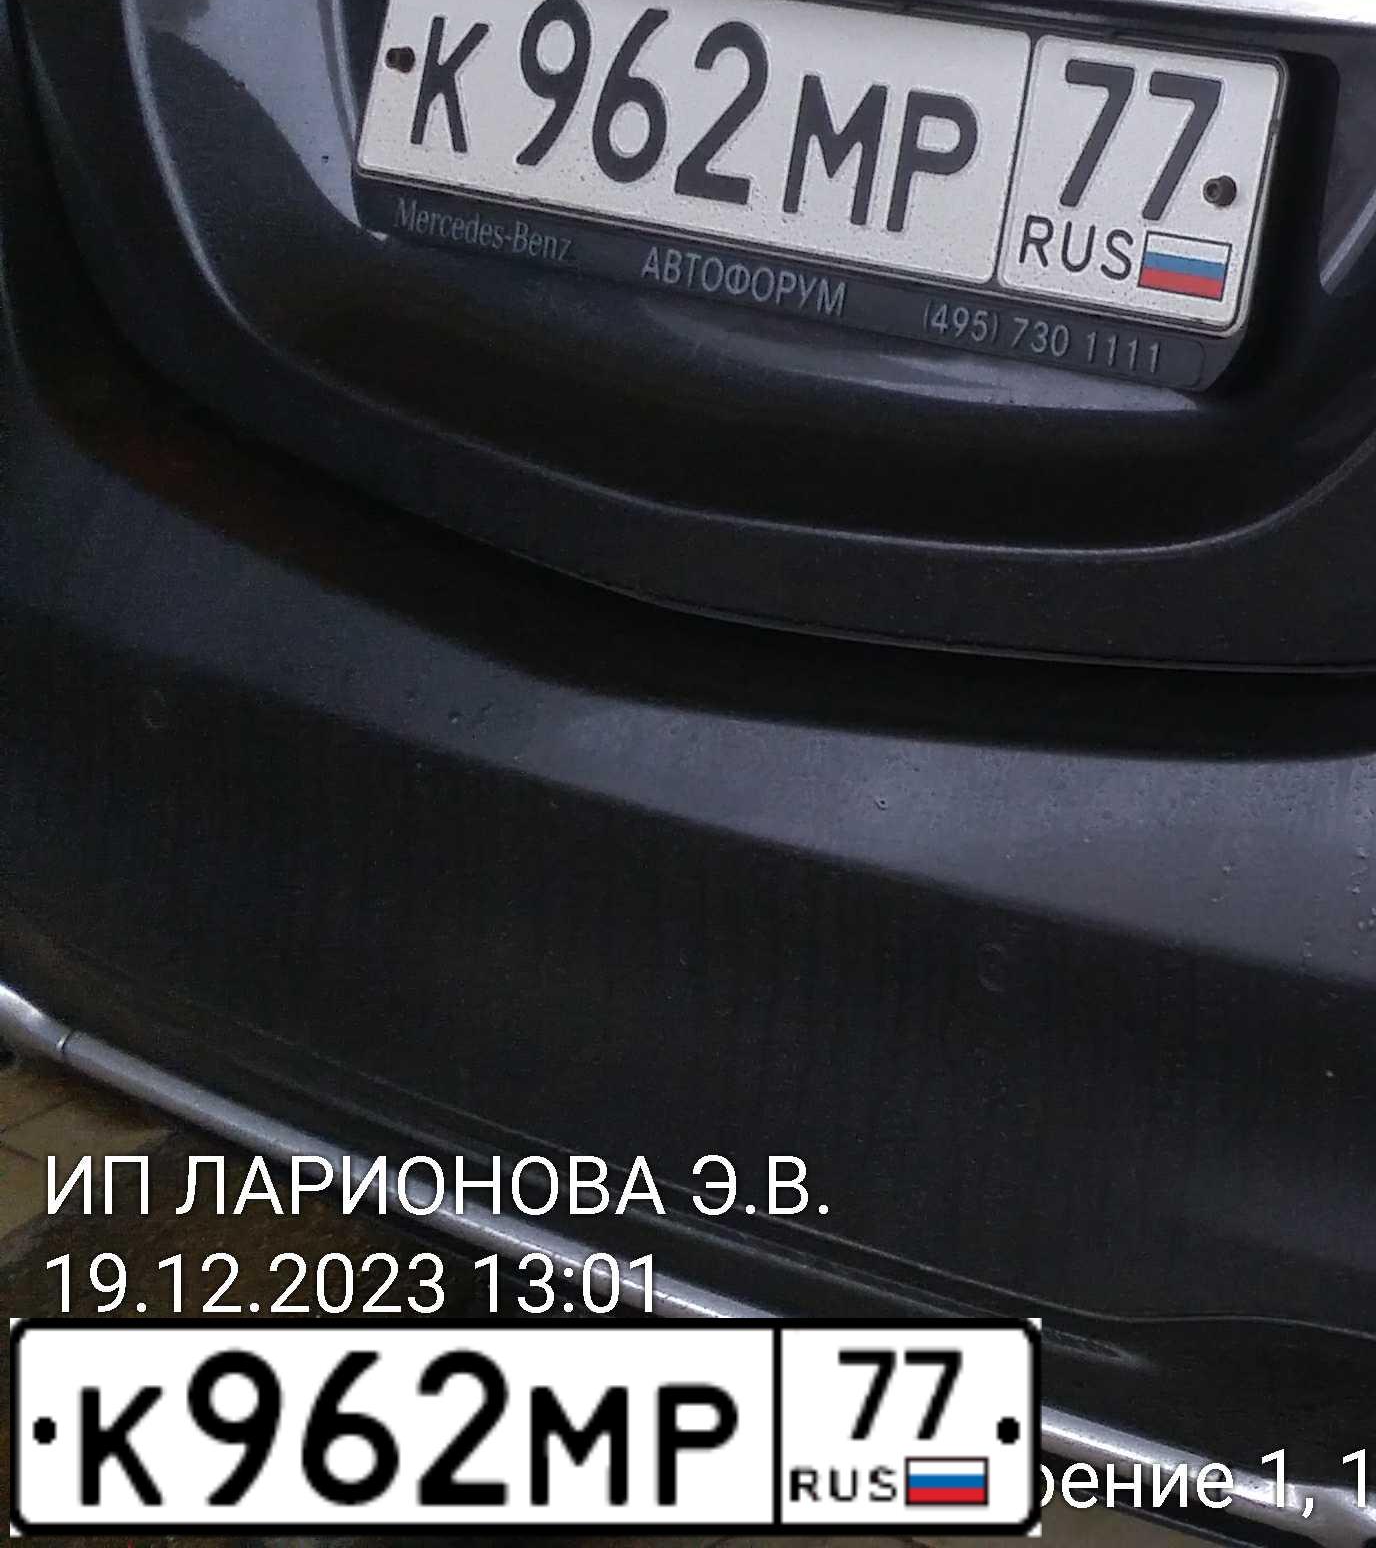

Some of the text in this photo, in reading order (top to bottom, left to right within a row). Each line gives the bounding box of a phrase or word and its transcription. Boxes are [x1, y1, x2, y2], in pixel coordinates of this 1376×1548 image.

[1064, 59, 1224, 222] 77
[394, 196, 574, 263] Mercedes-Benz
[1018, 213, 1134, 281] RUS
[641, 245, 848, 319] АВТОФОРУМ
[922, 299, 1161, 375] (495) 730 1111
